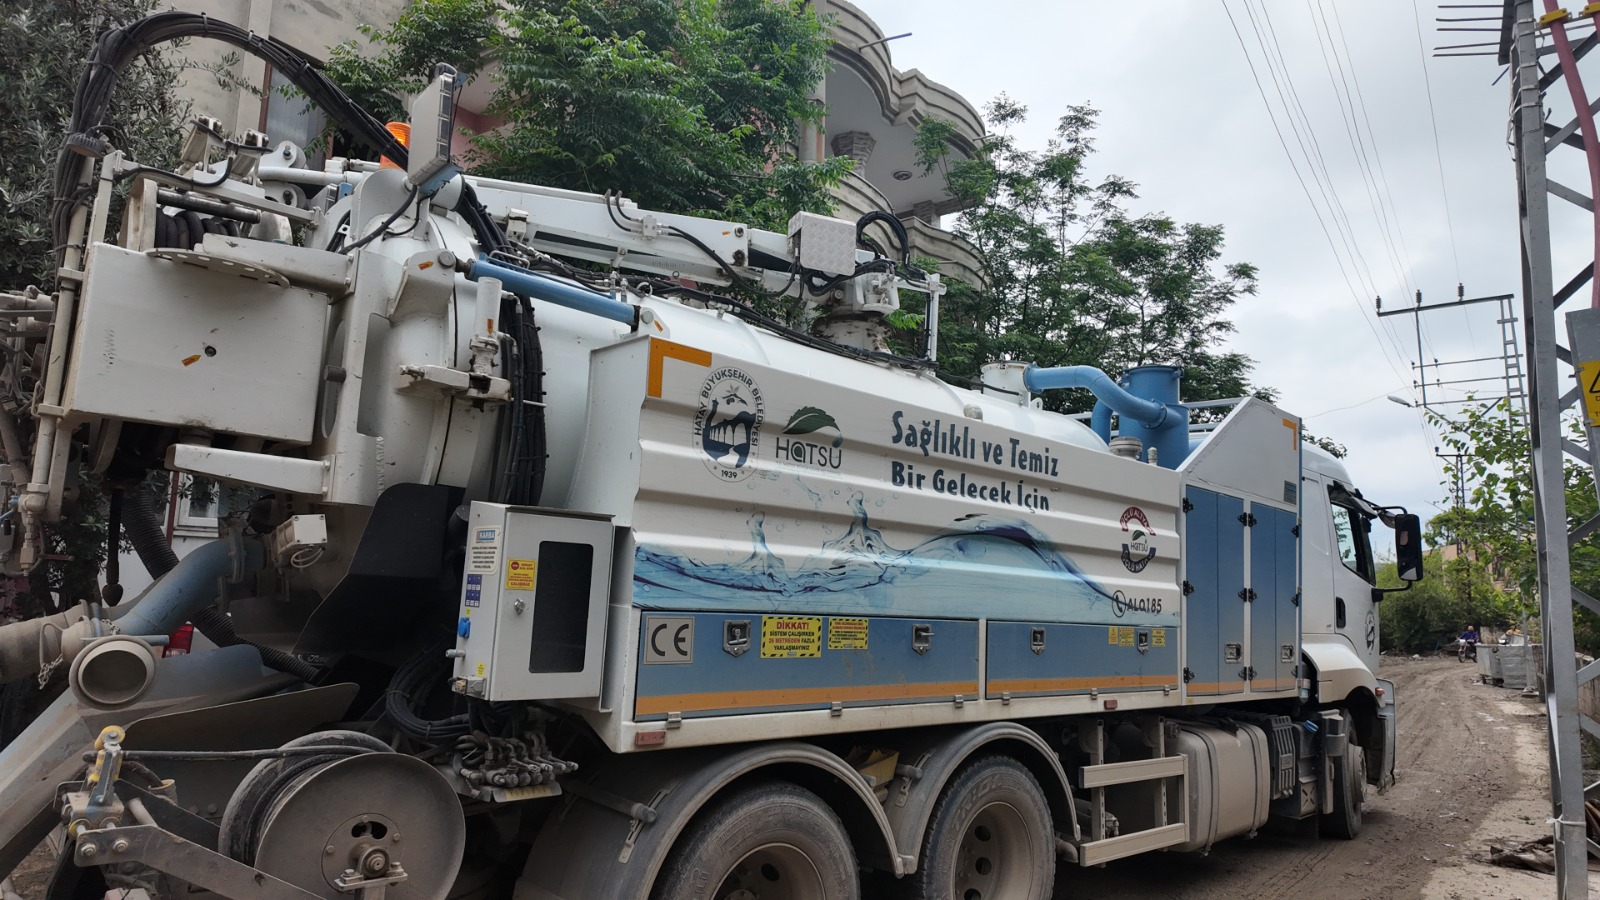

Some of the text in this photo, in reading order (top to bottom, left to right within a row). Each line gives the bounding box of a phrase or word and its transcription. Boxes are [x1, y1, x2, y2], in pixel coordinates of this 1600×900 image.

[891, 410, 1059, 477] Sağlıklı ve Temiz
[721, 469, 738, 479] 1939
[891, 460, 1050, 514] Bir Gelecek İçin
[651, 623, 689, 657] CE
